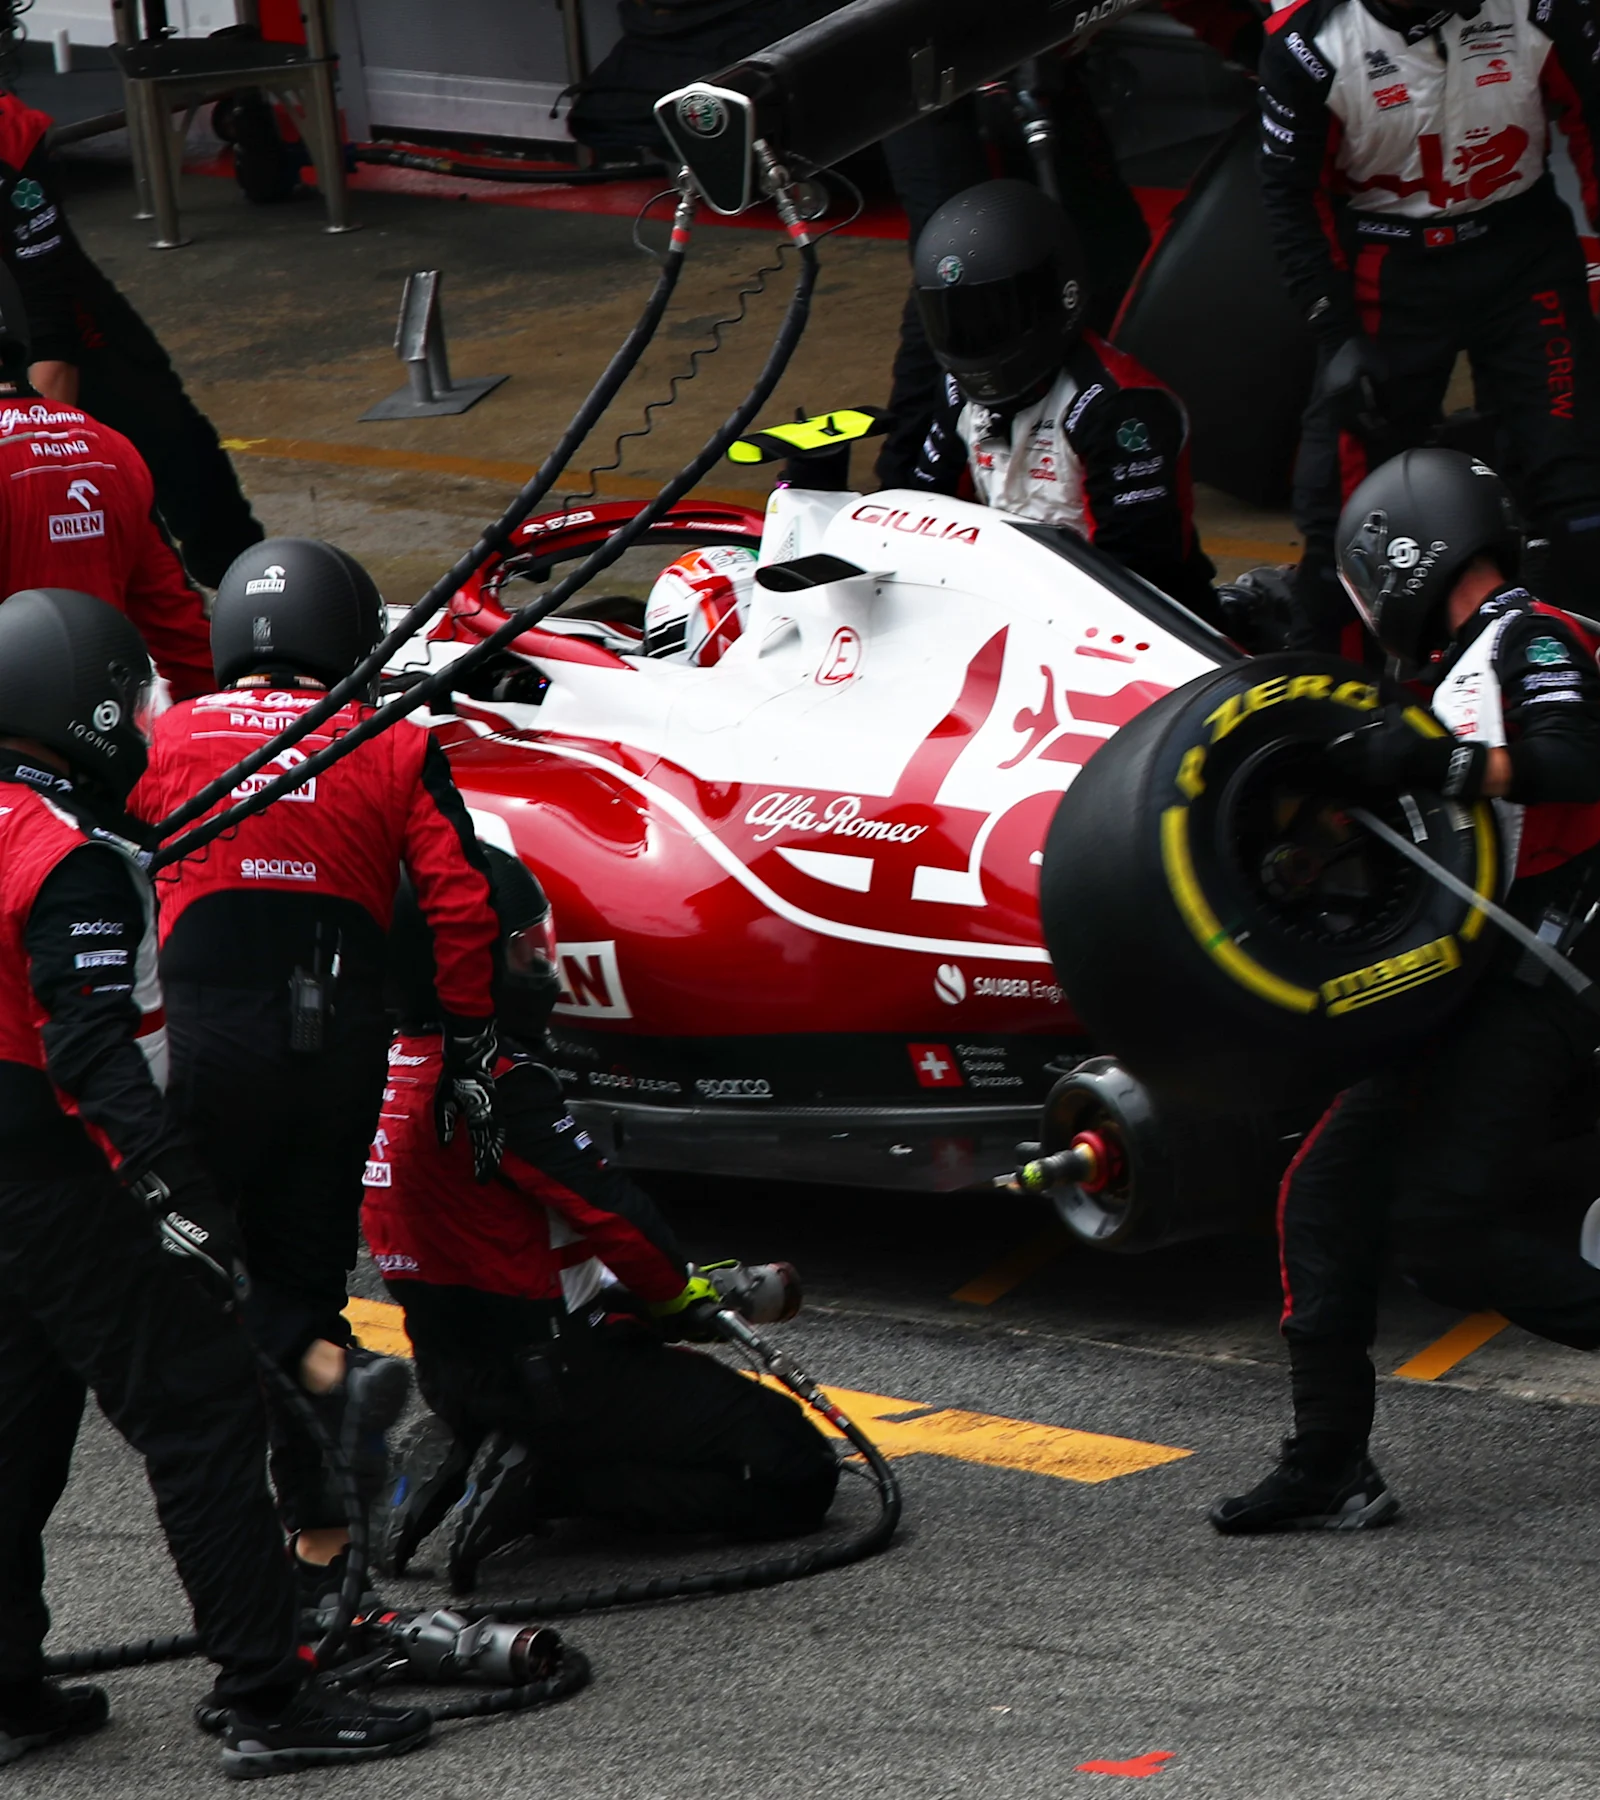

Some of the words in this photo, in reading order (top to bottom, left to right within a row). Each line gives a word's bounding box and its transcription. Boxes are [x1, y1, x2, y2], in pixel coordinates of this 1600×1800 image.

[1544, 337, 1575, 420] CREW
[30, 405, 86, 425] Romeo
[30, 440, 90, 457] RACING
[53, 515, 101, 536] ORLEN
[851, 505, 981, 545] GIULIA
[1202, 674, 1379, 745] ZERO
[744, 792, 820, 842] Alfa
[814, 795, 929, 843] Romeo
[973, 976, 1031, 998] SAUBER
[694, 1078, 773, 1099] sparco
[969, 1075, 1024, 1089] Svizzera
